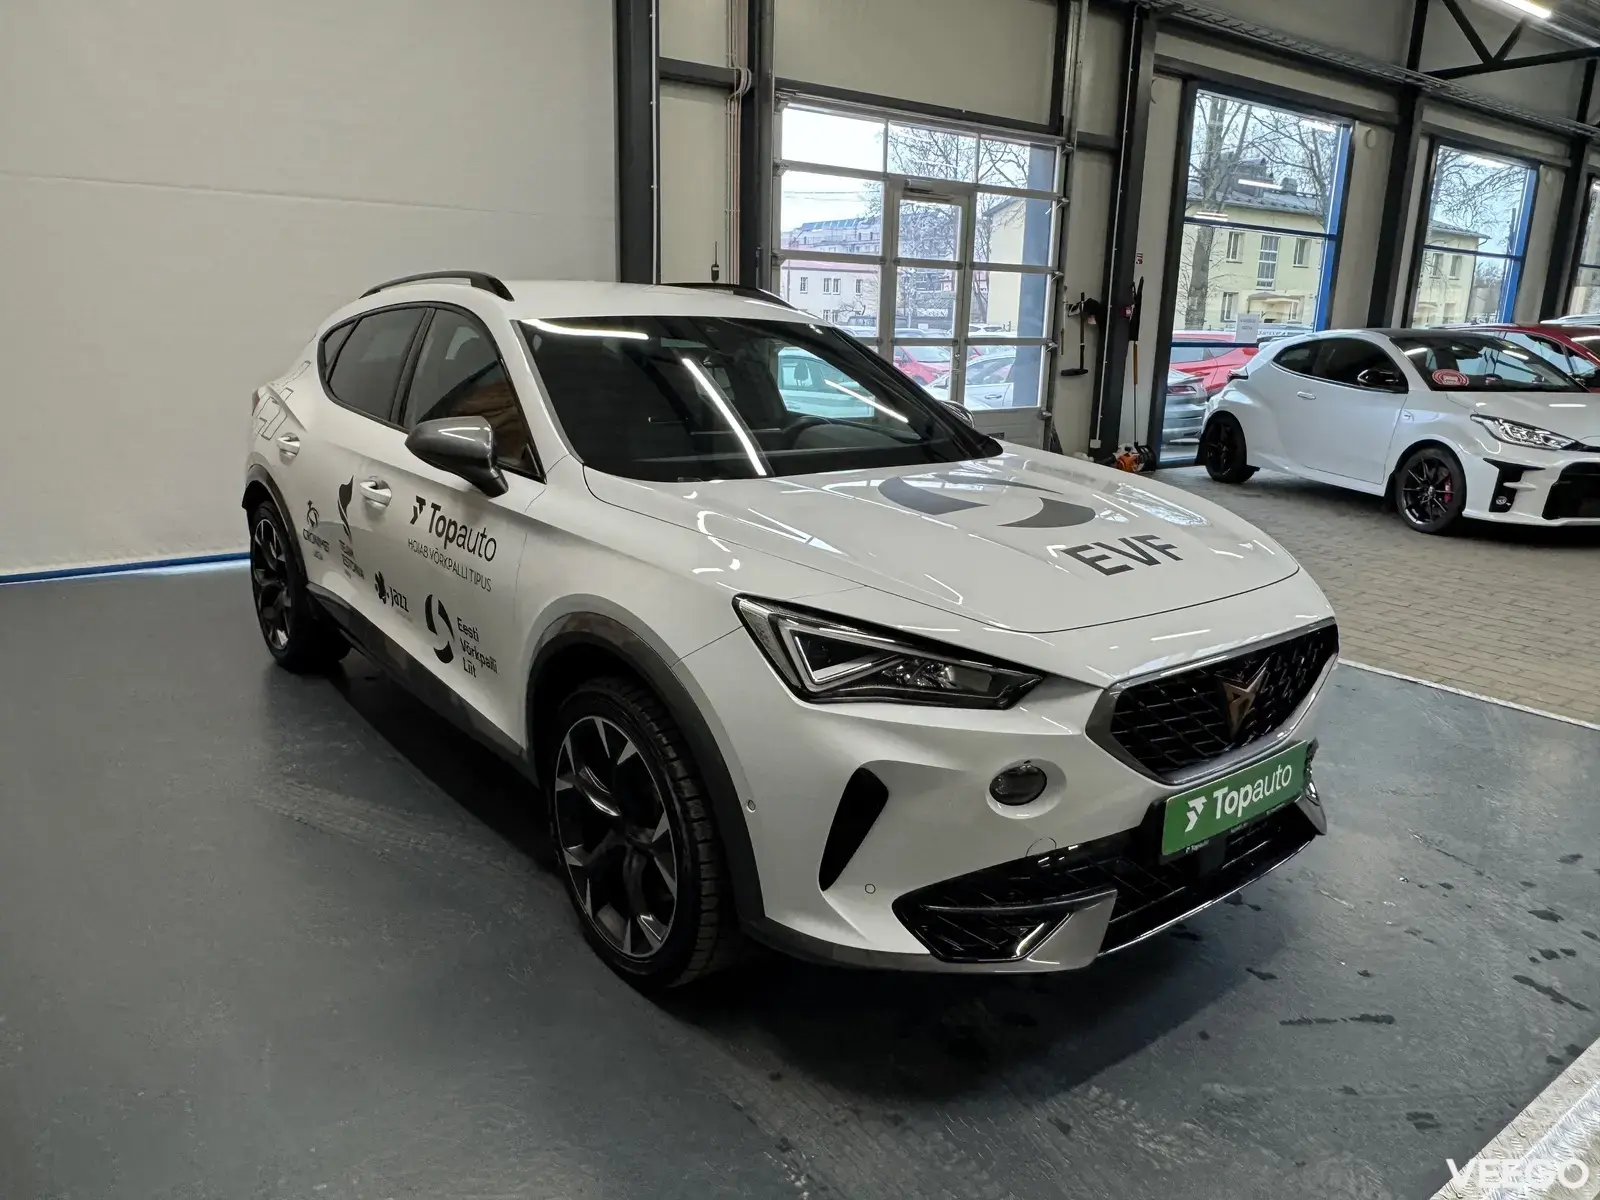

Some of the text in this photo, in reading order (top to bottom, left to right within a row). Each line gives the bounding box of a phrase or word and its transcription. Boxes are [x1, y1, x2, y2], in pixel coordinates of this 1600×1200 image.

[428, 502, 497, 562] Topauto
[1060, 535, 1183, 576] EVF
[469, 568, 492, 592] TIPUS
[457, 616, 480, 643] Eesti
[463, 656, 476, 678] Liit
[1212, 764, 1293, 820] Topauto
